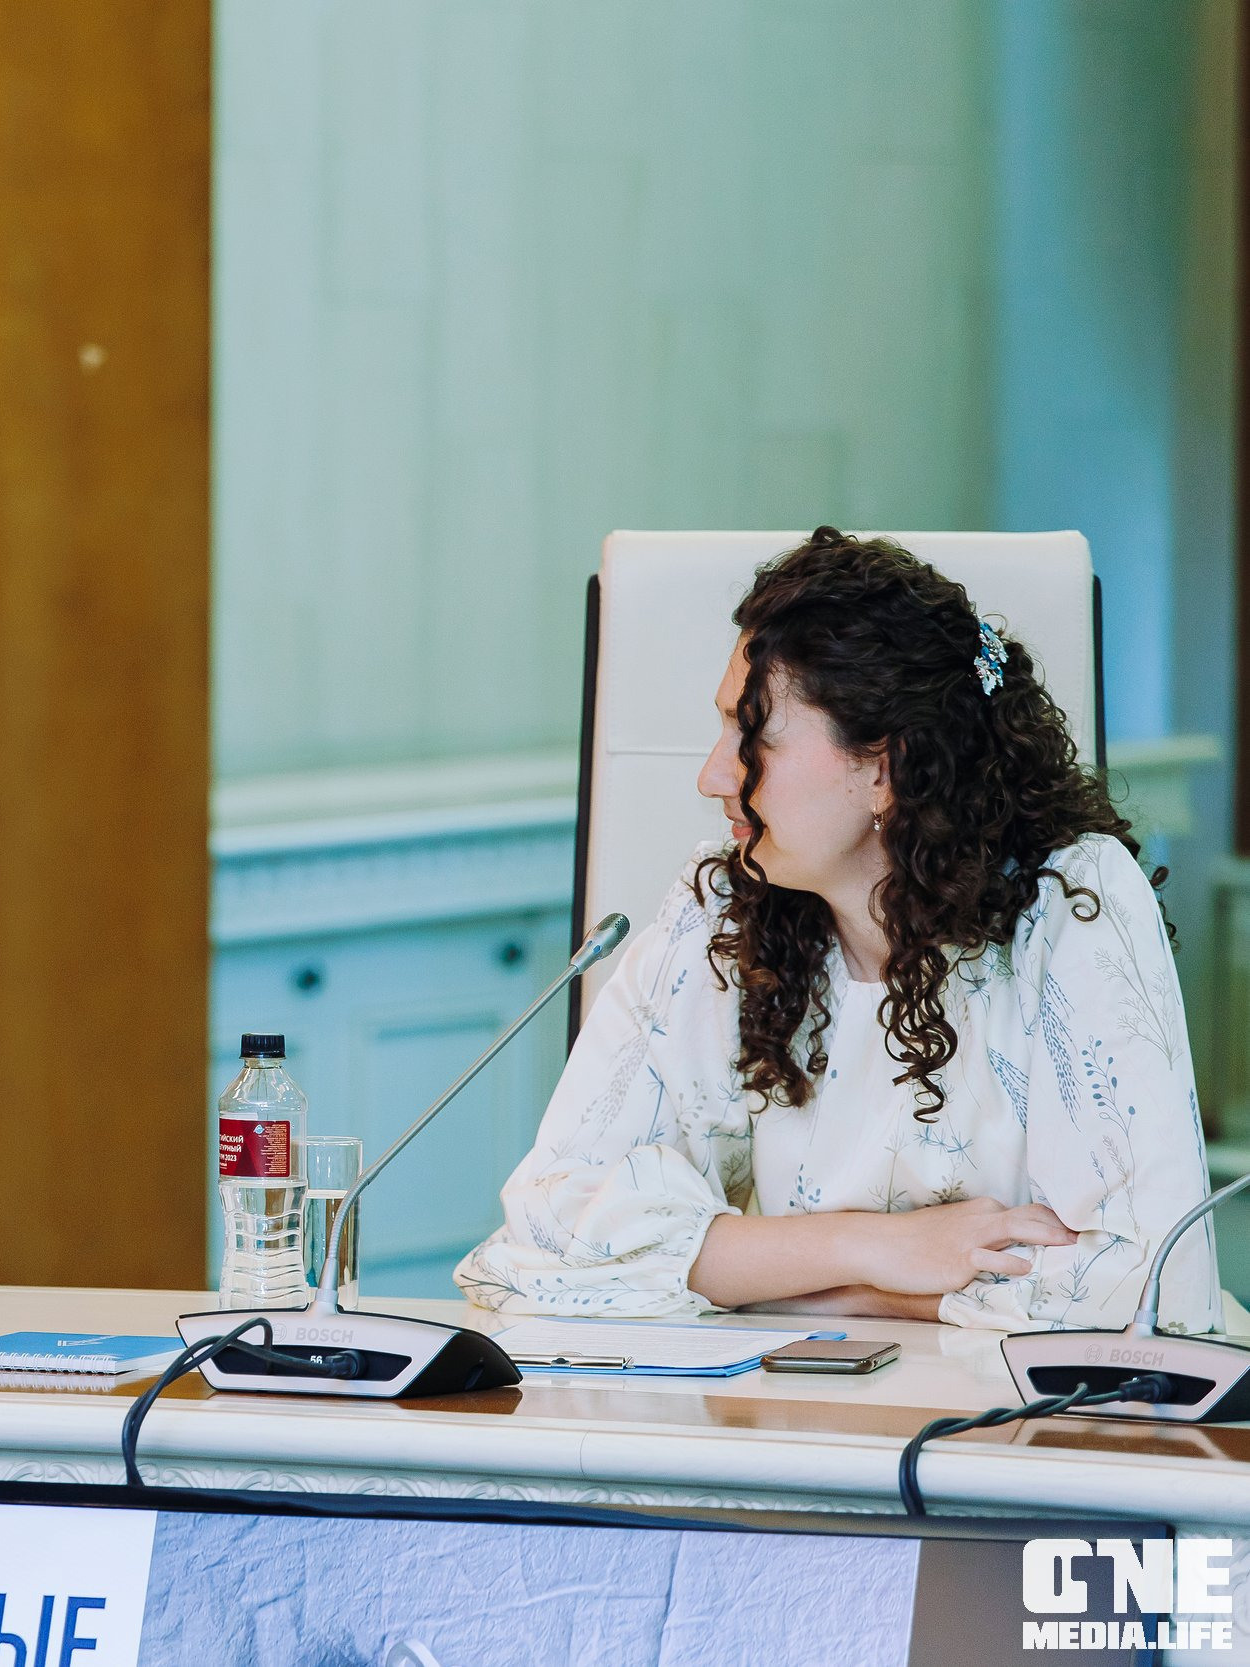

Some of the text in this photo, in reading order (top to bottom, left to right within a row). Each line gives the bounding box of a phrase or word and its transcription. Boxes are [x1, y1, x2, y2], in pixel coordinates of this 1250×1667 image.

[295, 1327, 354, 1343] BOSCH
[310, 1355, 323, 1365] 56
[1109, 1348, 1165, 1366] BOSCH
